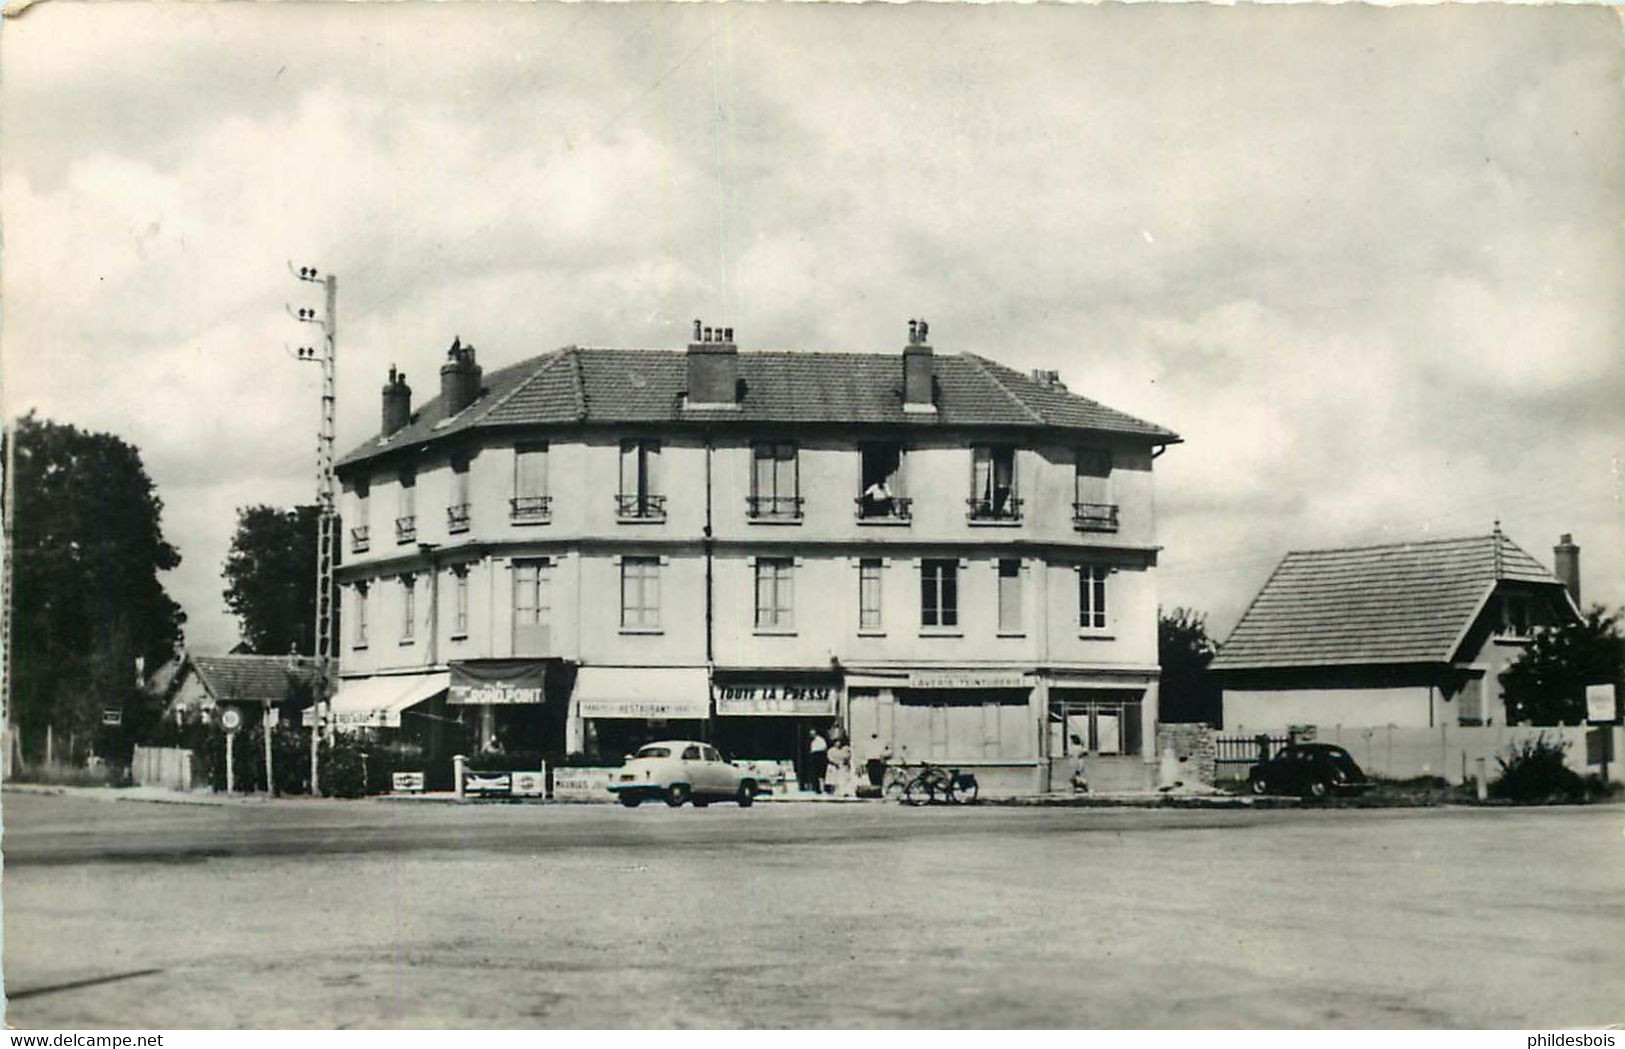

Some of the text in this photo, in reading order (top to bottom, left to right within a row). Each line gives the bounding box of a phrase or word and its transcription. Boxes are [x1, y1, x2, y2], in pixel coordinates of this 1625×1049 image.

[720, 685, 830, 701] TOUTE LA PRESSE
